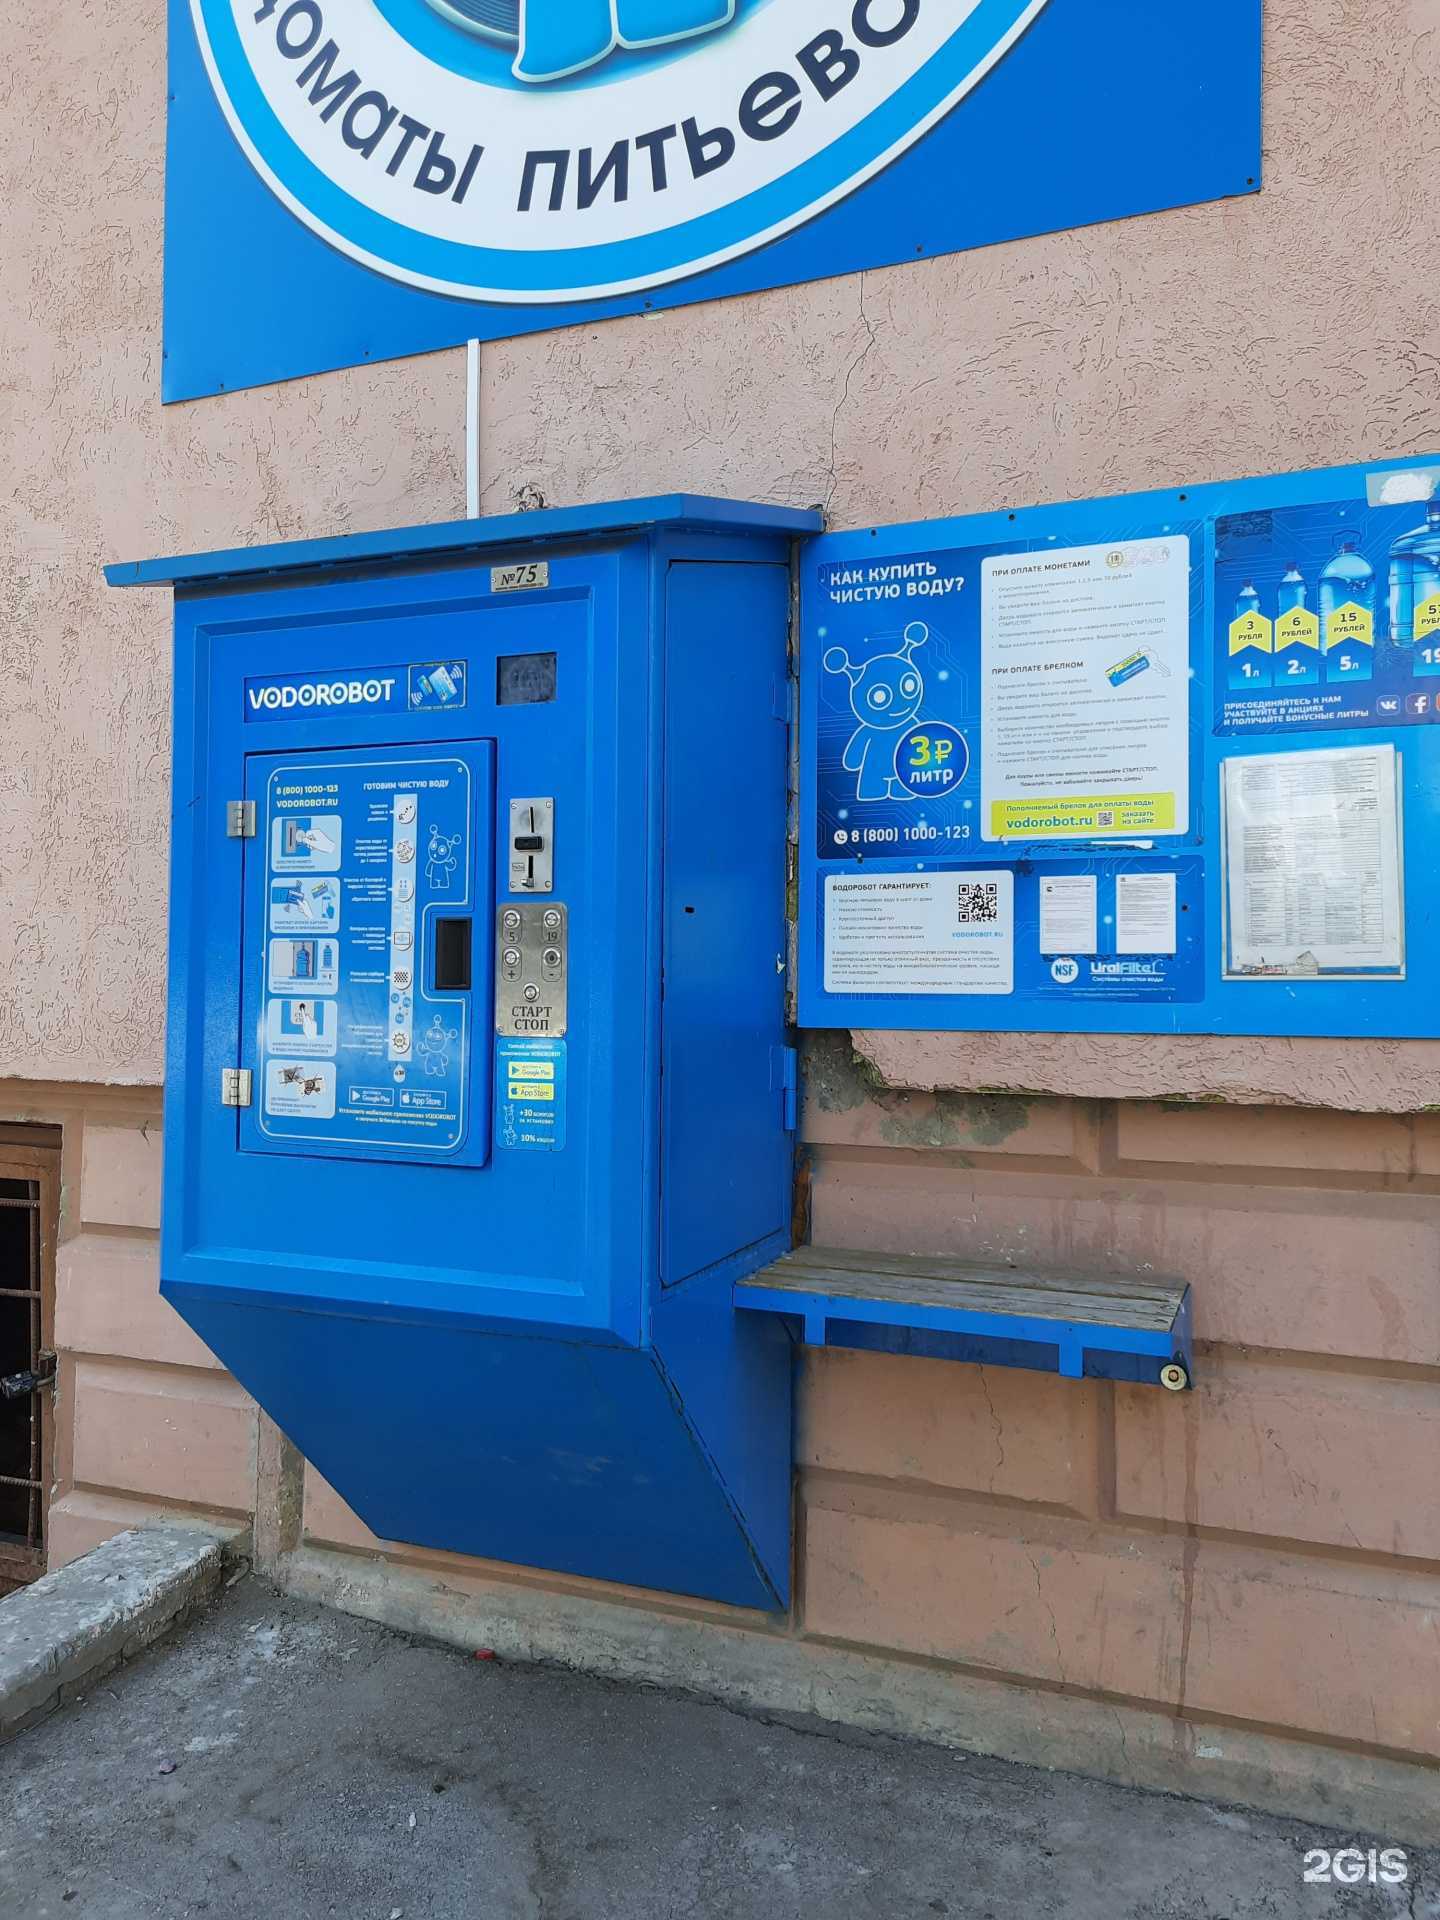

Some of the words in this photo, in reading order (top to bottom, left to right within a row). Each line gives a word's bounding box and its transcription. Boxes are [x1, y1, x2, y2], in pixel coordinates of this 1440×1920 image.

[516, 0, 921, 213] питьево
[830, 570, 863, 586] КАК
[869, 562, 937, 582] КУПИТЬ
[992, 569, 1009, 577] ПРИ
[1011, 565, 1042, 576] ОПЛАТЕ
[1044, 560, 1091, 572] МОНЕТАМИ
[830, 582, 901, 604] ЧИСТУЮ
[906, 577, 965, 598] ВОДУ?
[1292, 617, 1301, 627] 6
[1340, 612, 1357, 623] 15
[1246, 620, 1254, 631] 3
[1333, 624, 1366, 633] РУБЛЕЙ
[1238, 633, 1263, 641] РУБЛЯ
[1281, 629, 1312, 638] РУБЛЕЙ
[992, 667, 1009, 675] ПРИ
[1011, 664, 1042, 674] ОПЛАТЕ
[1044, 661, 1084, 671] БРЕЛКОМ
[249, 679, 396, 710] VODOROBOT
[1224, 698, 1311, 710] ПРИСОЕДИНЯЙТЕСЬ
[1224, 707, 1278, 718] УЧАСТВУЙТЕ
[1288, 705, 1325, 714] АКЦИЯХ
[1232, 716, 1284, 726] ПОЛУЧАЙТЕ
[1286, 712, 1335, 722] БОНУСНЫЕ
[1337, 710, 1369, 719] ЛИТРЫ
[909, 768, 954, 785] литр
[276, 786, 281, 795] 8
[282, 786, 303, 796] (800)
[304, 784, 339, 794] 1000-123
[363, 782, 397, 791] ГОТОВИМ
[398, 780, 427, 789] ЧИСТУЮ
[429, 779, 449, 788] ВОДУ
[276, 798, 339, 808] VODOROBOT.RU
[1006, 803, 1059, 812] Пополняемый
[1087, 801, 1103, 810] для
[1104, 799, 1132, 808] оплаты
[1133, 799, 1154, 807] воды
[1006, 815, 1093, 829] vodorobot.ru
[1133, 816, 1155, 825] сайте
[851, 830, 860, 843] 8
[863, 828, 899, 844] (800)
[903, 826, 970, 842] 1000-123
[832, 884, 877, 892] ВОДОРОБОТ
[509, 932, 515, 942] 5
[547, 932, 558, 942] 19
[1055, 964, 1075, 977] NSF
[511, 1006, 553, 1018] СТАРТ
[514, 1019, 549, 1031] СТОП
[520, 1089, 534, 1097] App
[412, 1097, 425, 1106] App
[521, 1134, 536, 1142] 10%
